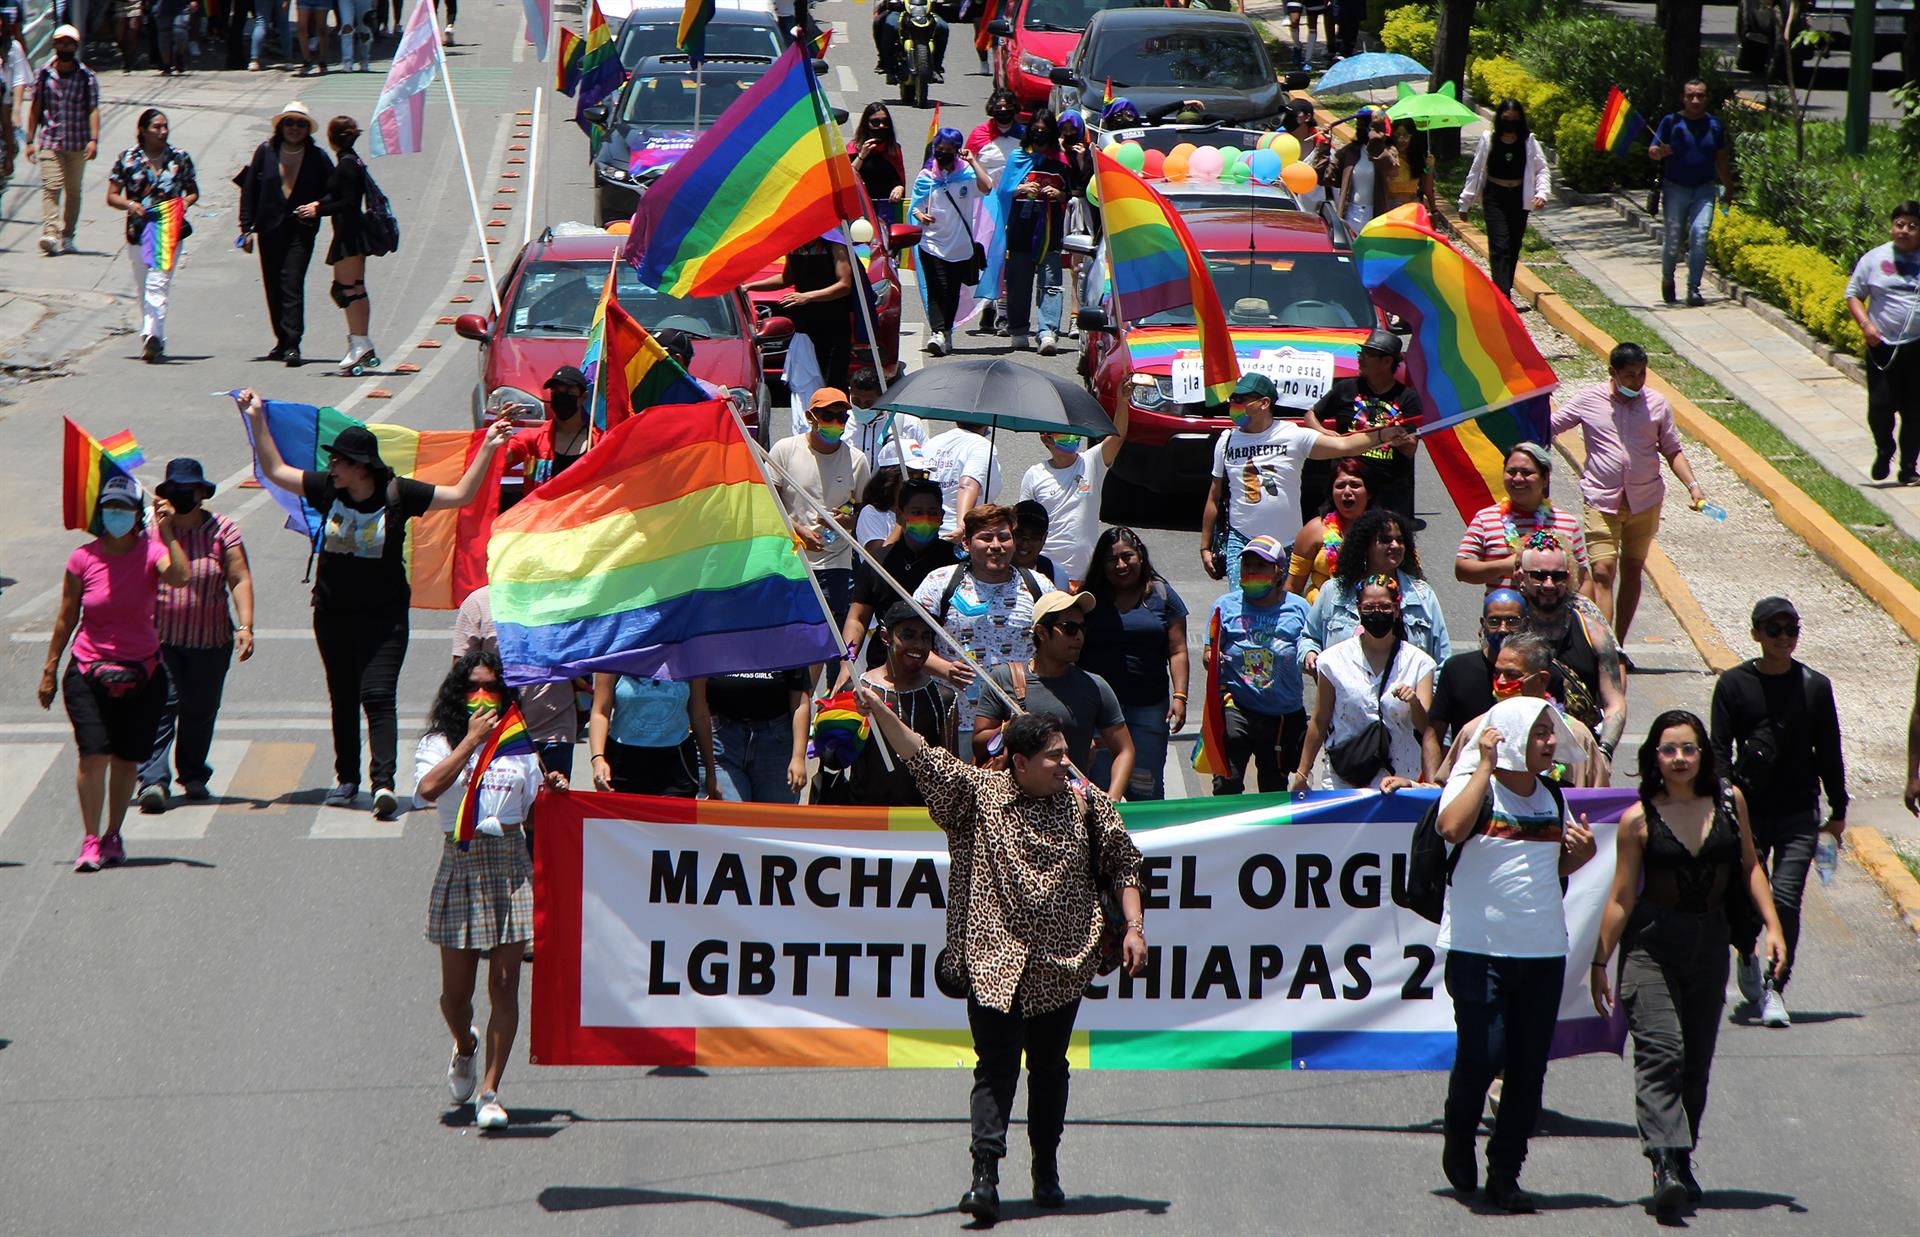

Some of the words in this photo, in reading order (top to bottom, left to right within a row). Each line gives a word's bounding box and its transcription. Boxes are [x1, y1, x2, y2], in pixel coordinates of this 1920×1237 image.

[1278, 364, 1292, 374] no
[1283, 380, 1299, 395] no
[1225, 444, 1288, 461] MADRECITA
[649, 850, 947, 908] MARCHA
